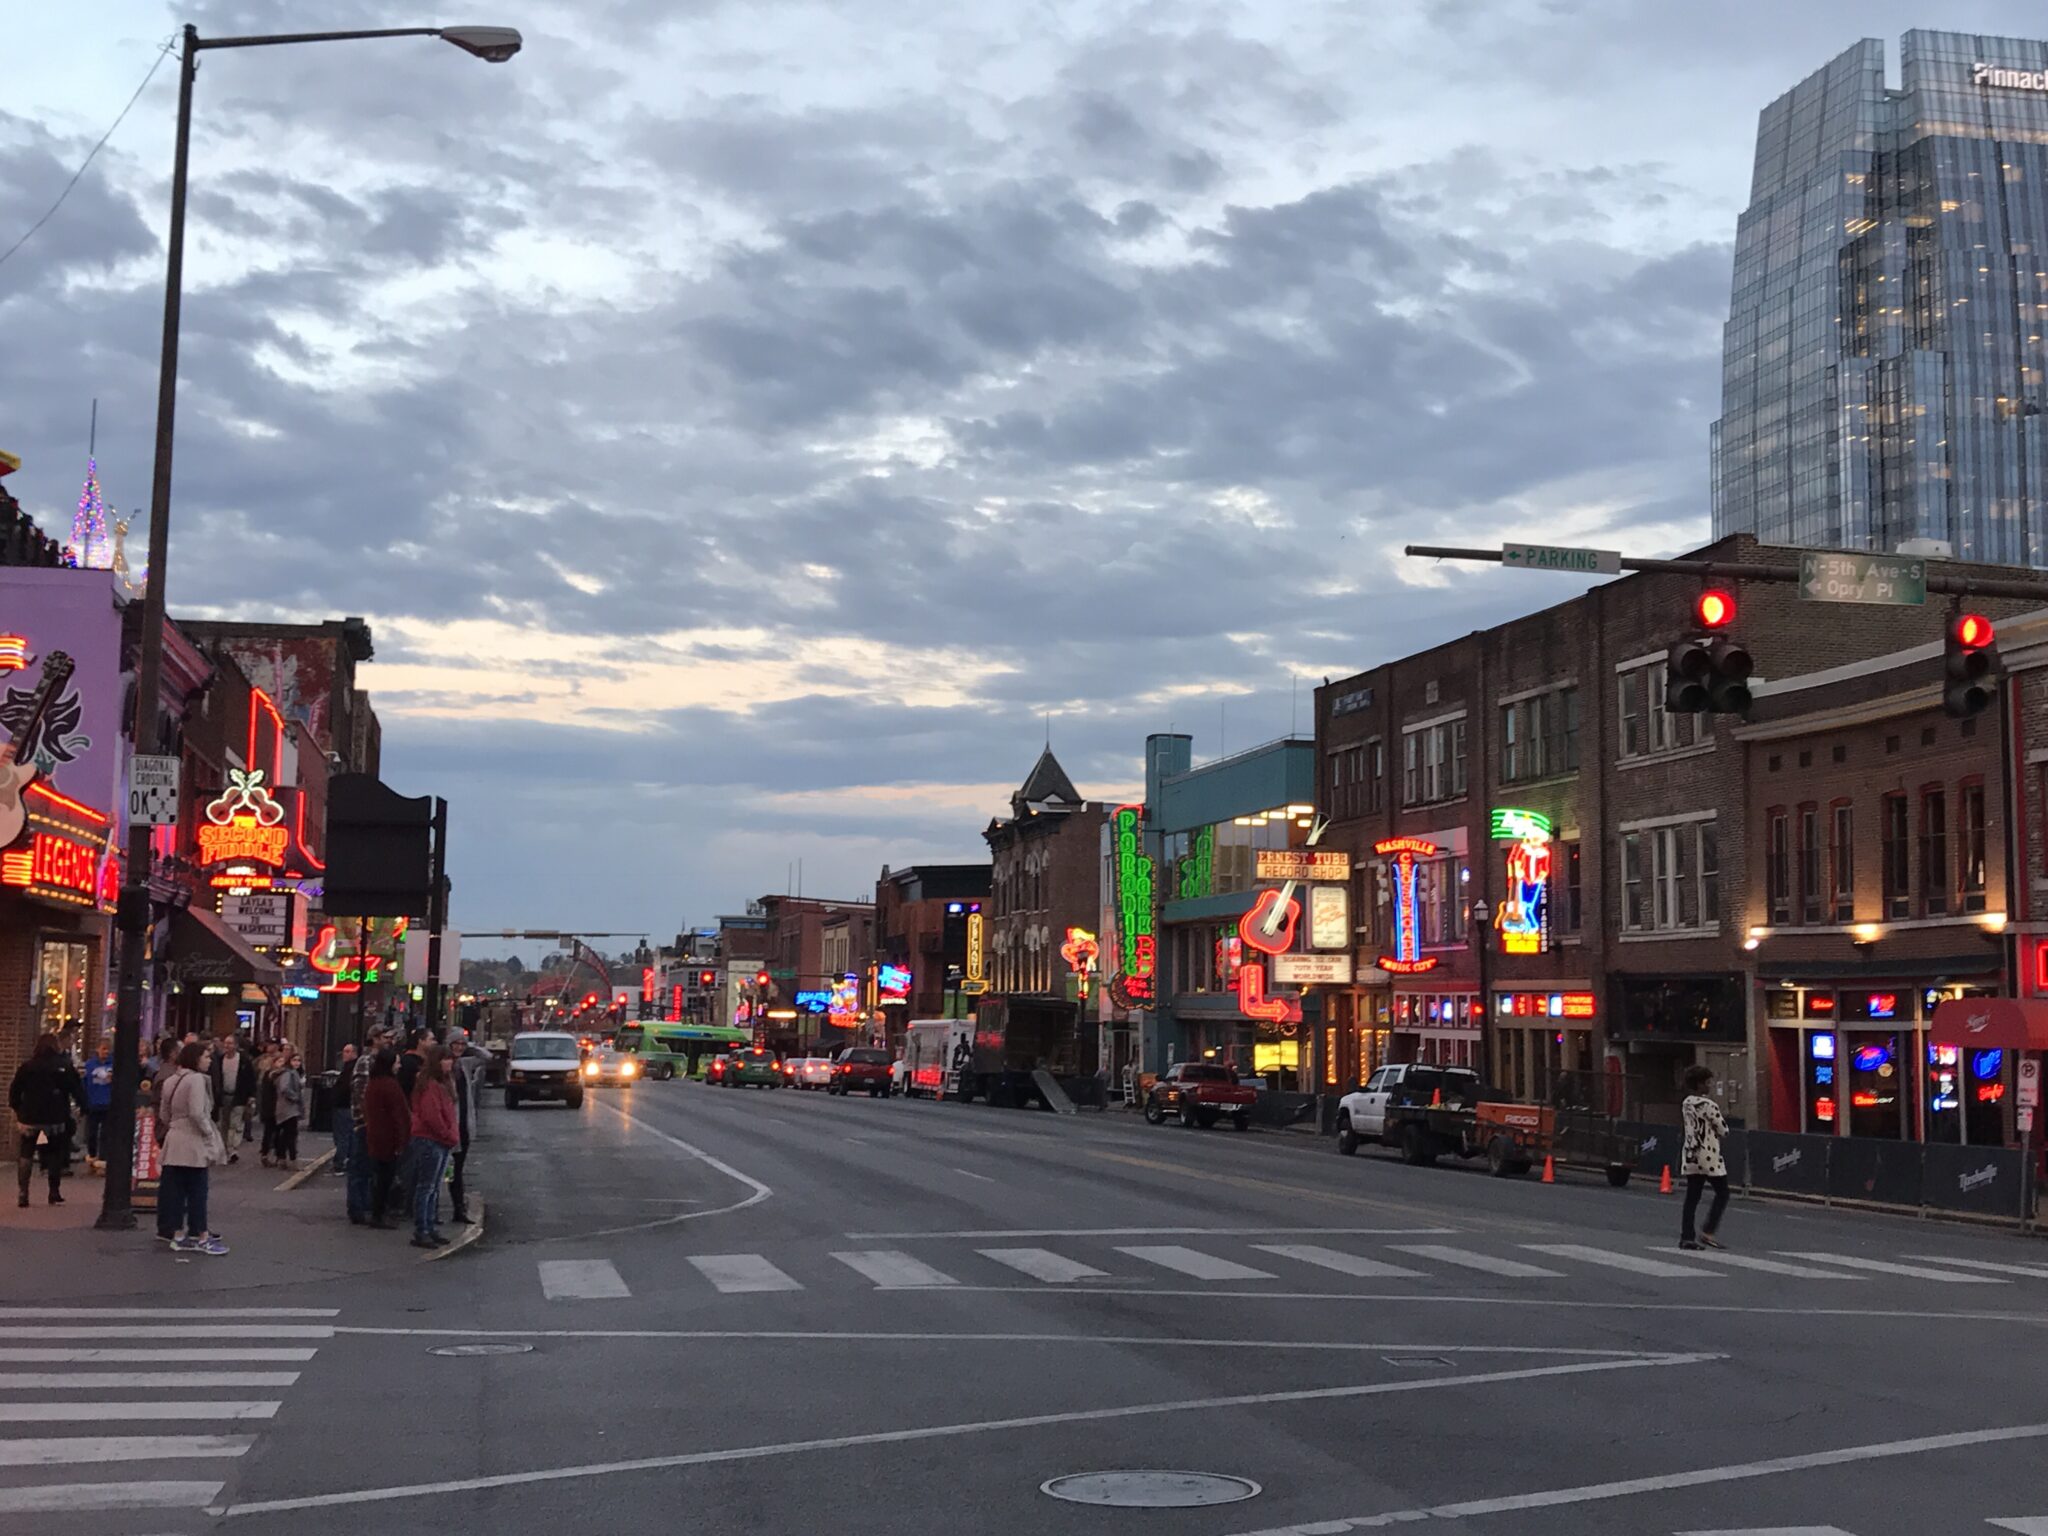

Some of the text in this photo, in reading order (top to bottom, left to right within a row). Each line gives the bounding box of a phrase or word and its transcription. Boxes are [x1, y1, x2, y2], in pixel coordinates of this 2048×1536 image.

[1525, 548, 1598, 570] PARKING
[1827, 581, 1864, 599] Opry
[135, 759, 174, 773] DIAGONAL
[135, 772, 174, 787] CROSSING
[131, 790, 150, 815] OK
[199, 825, 289, 849] SECOND
[1374, 838, 1437, 856] NASHVILLE
[34, 832, 97, 893] LEGENDS
[201, 842, 284, 866] FIDDLE
[1258, 851, 1348, 864] ERNEST TUBB
[1264, 865, 1343, 878] RECORD SHOP
[240, 897, 274, 906] LAYLA'S
[1119, 810, 1138, 977] PARADISE
[1137, 856, 1152, 936] PARK
[238, 906, 275, 916] WELCOME
[1399, 852, 1413, 961] CROSSROADS
[238, 925, 276, 935] NASHVILLE
[137, 1116, 152, 1180] LEGENDS
